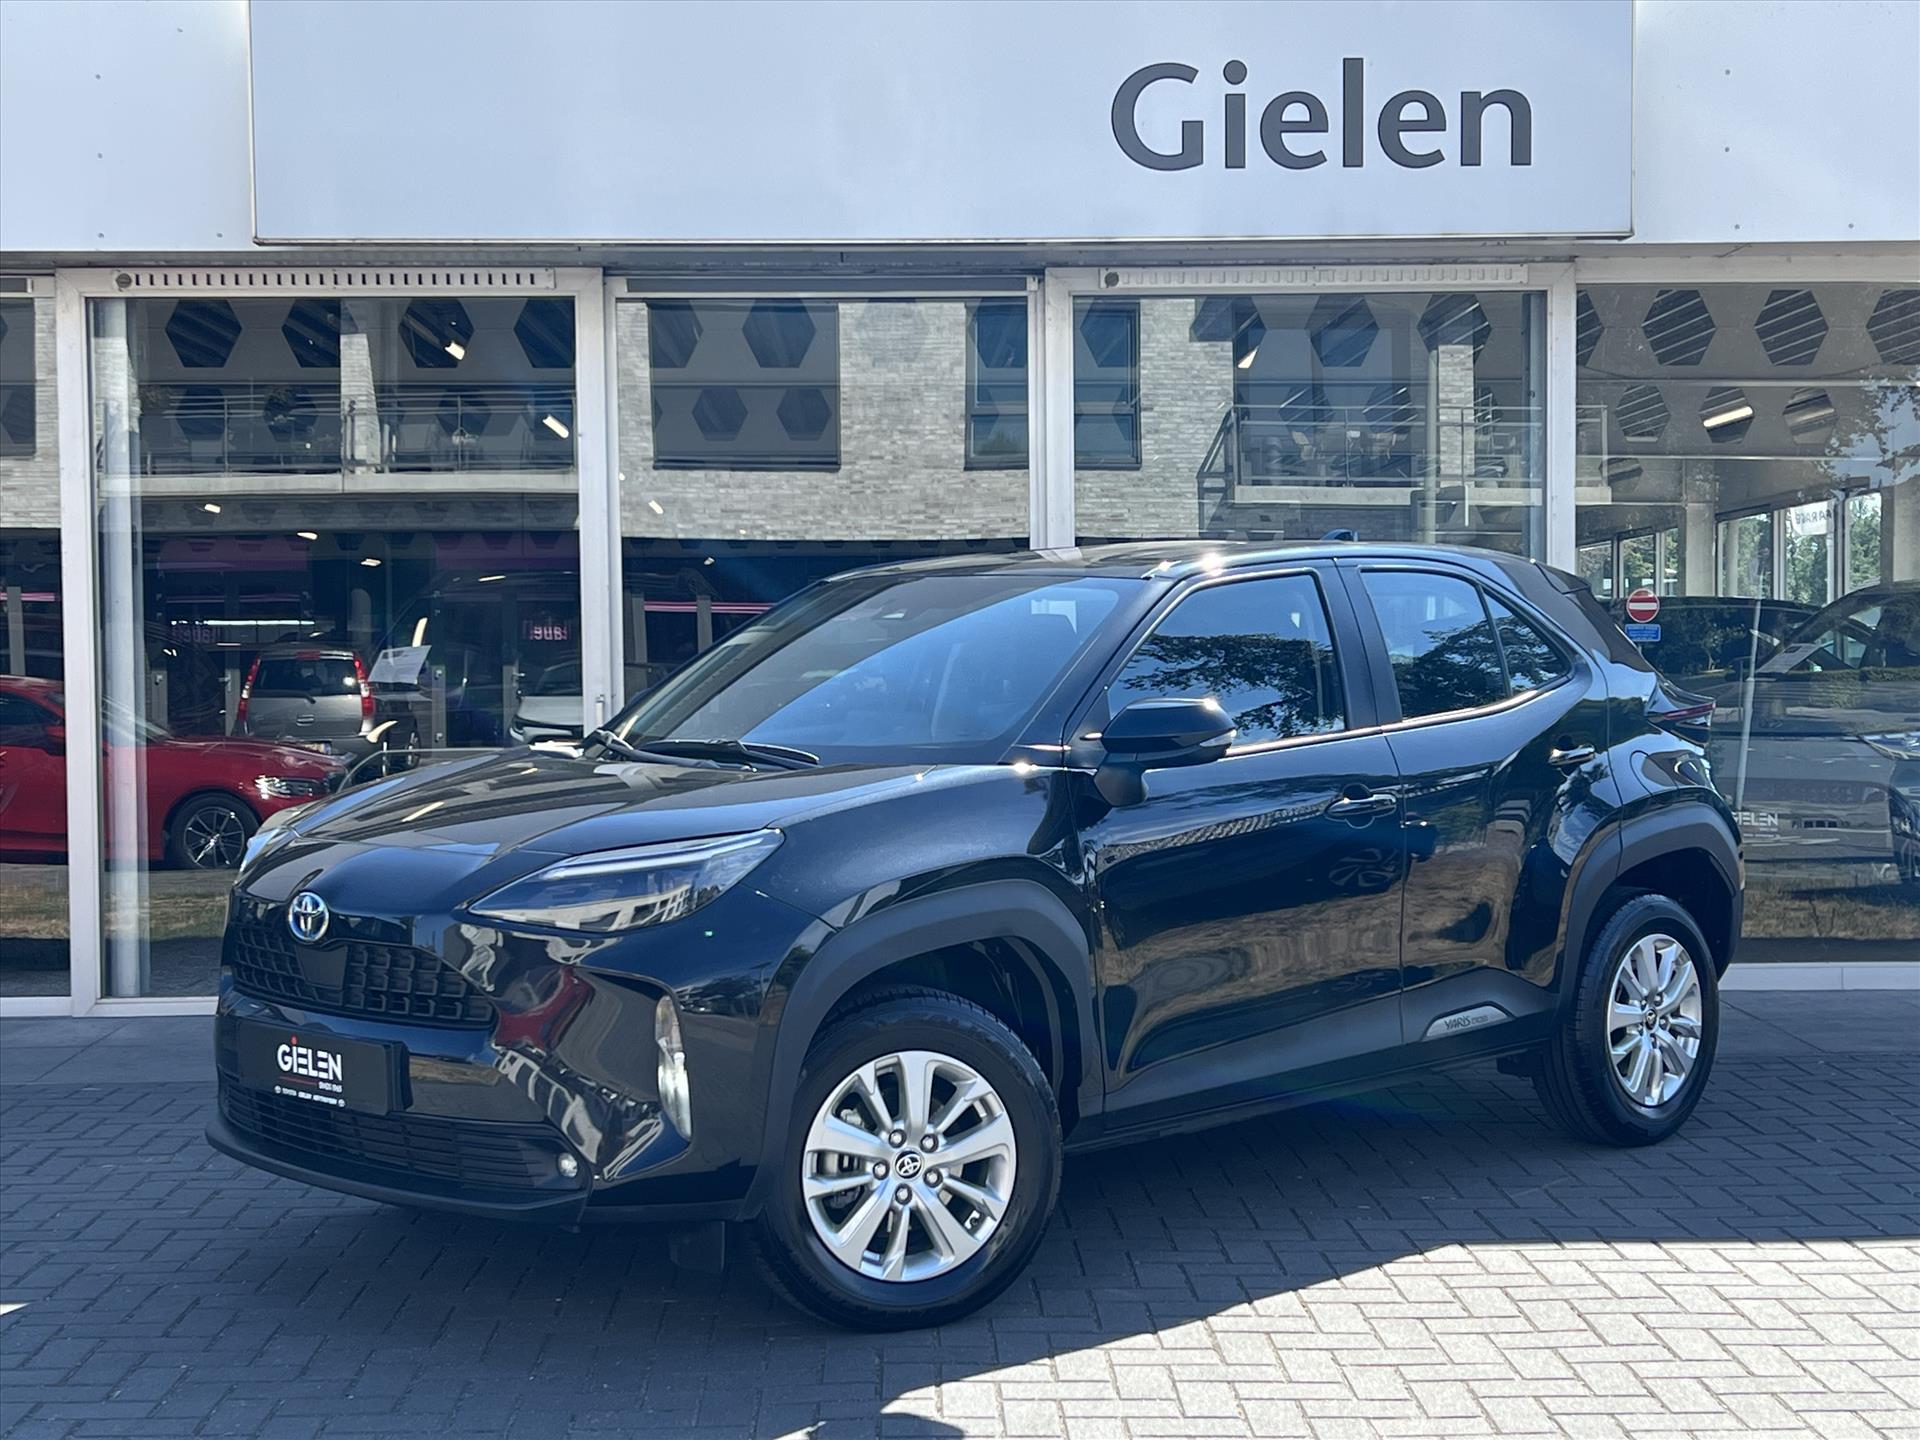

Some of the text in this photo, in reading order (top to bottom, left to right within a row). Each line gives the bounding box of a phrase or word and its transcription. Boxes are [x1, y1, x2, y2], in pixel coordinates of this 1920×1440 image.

[1111, 57, 1532, 171] Gielen
[1444, 1015, 1471, 1030] YARIS
[277, 1035, 342, 1081] GIELEN
